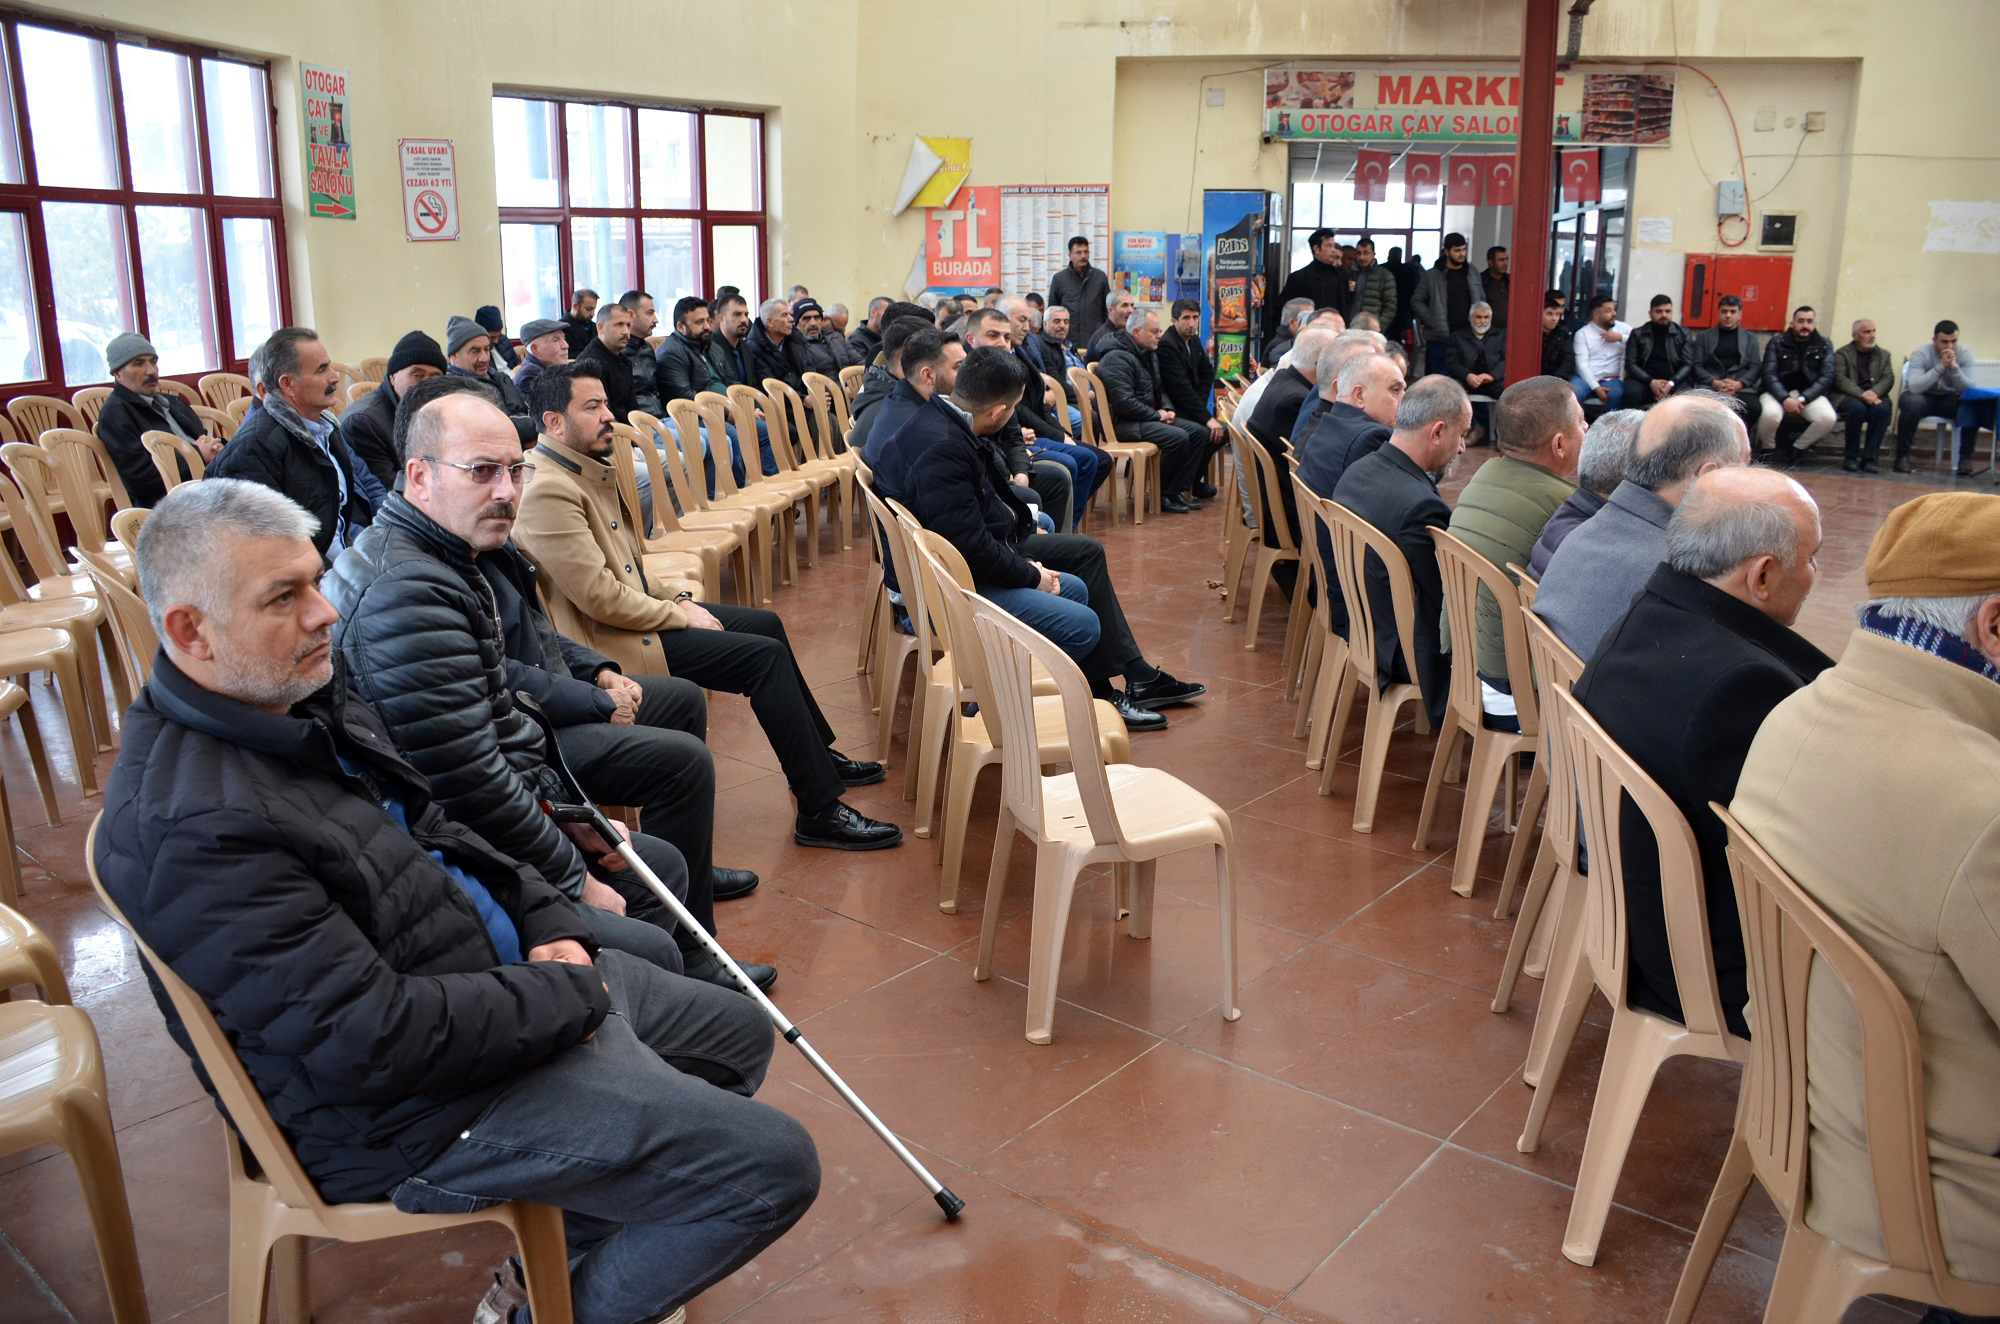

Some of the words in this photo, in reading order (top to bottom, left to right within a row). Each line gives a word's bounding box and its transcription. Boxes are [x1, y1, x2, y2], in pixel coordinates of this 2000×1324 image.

[304, 69, 346, 97] OTOGAR
[1377, 75, 1564, 106] MARK
[307, 98, 328, 121] ÇAY
[318, 125, 329, 137] VE
[1300, 113, 1394, 133] OTOGAR
[1401, 114, 1445, 138] ÇAY
[1452, 115, 1520, 135] SALO
[309, 143, 349, 169] TAVLA
[405, 146, 426, 154] YASAL
[427, 147, 448, 155] UYARI
[310, 171, 353, 196] SALONU
[406, 179, 429, 187] CEZASI
[430, 179, 440, 187] 62
[441, 179, 453, 187] YTL
[932, 208, 992, 258] TL
[933, 261, 992, 276] BURADA
